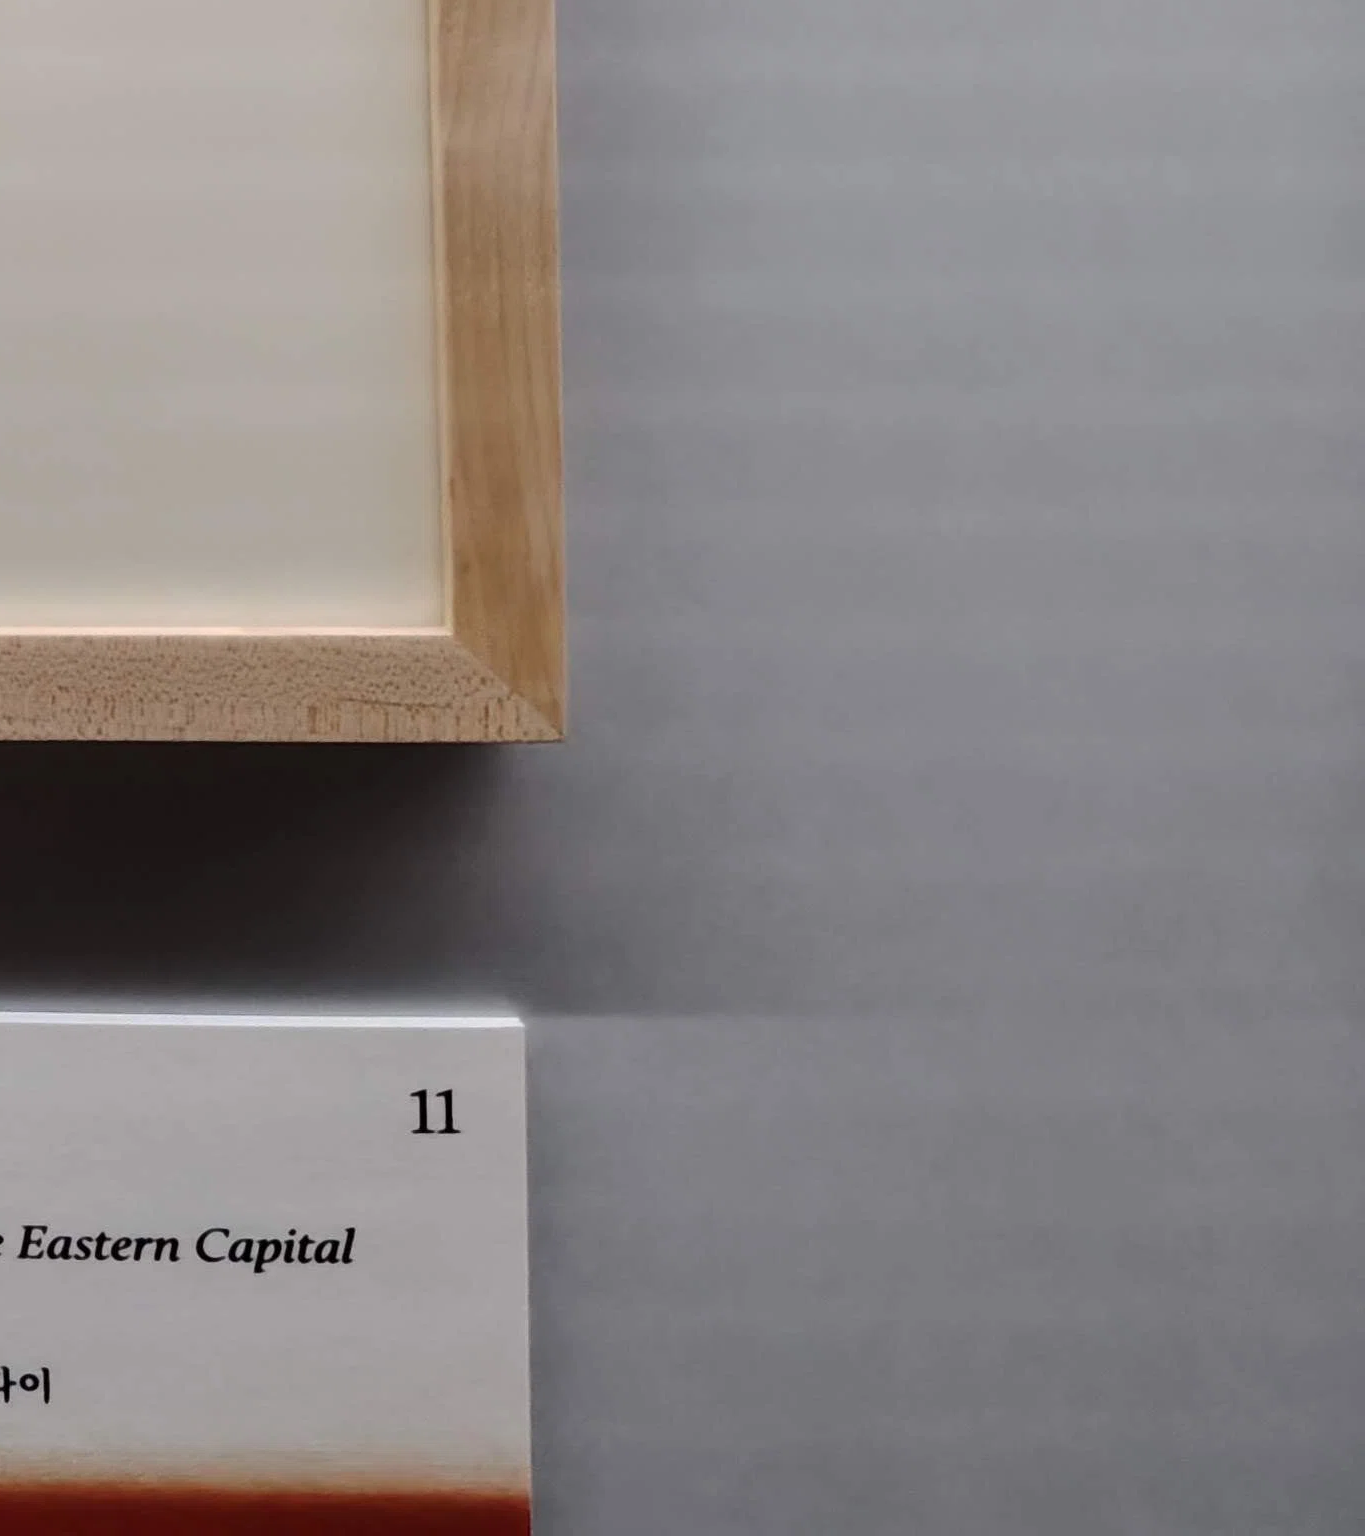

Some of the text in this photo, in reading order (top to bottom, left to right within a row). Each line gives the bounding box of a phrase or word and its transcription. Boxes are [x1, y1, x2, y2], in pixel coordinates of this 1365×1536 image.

[409, 1088, 462, 1135] 11
[16, 1224, 181, 1263] Eastern
[195, 1226, 356, 1274] Capital
